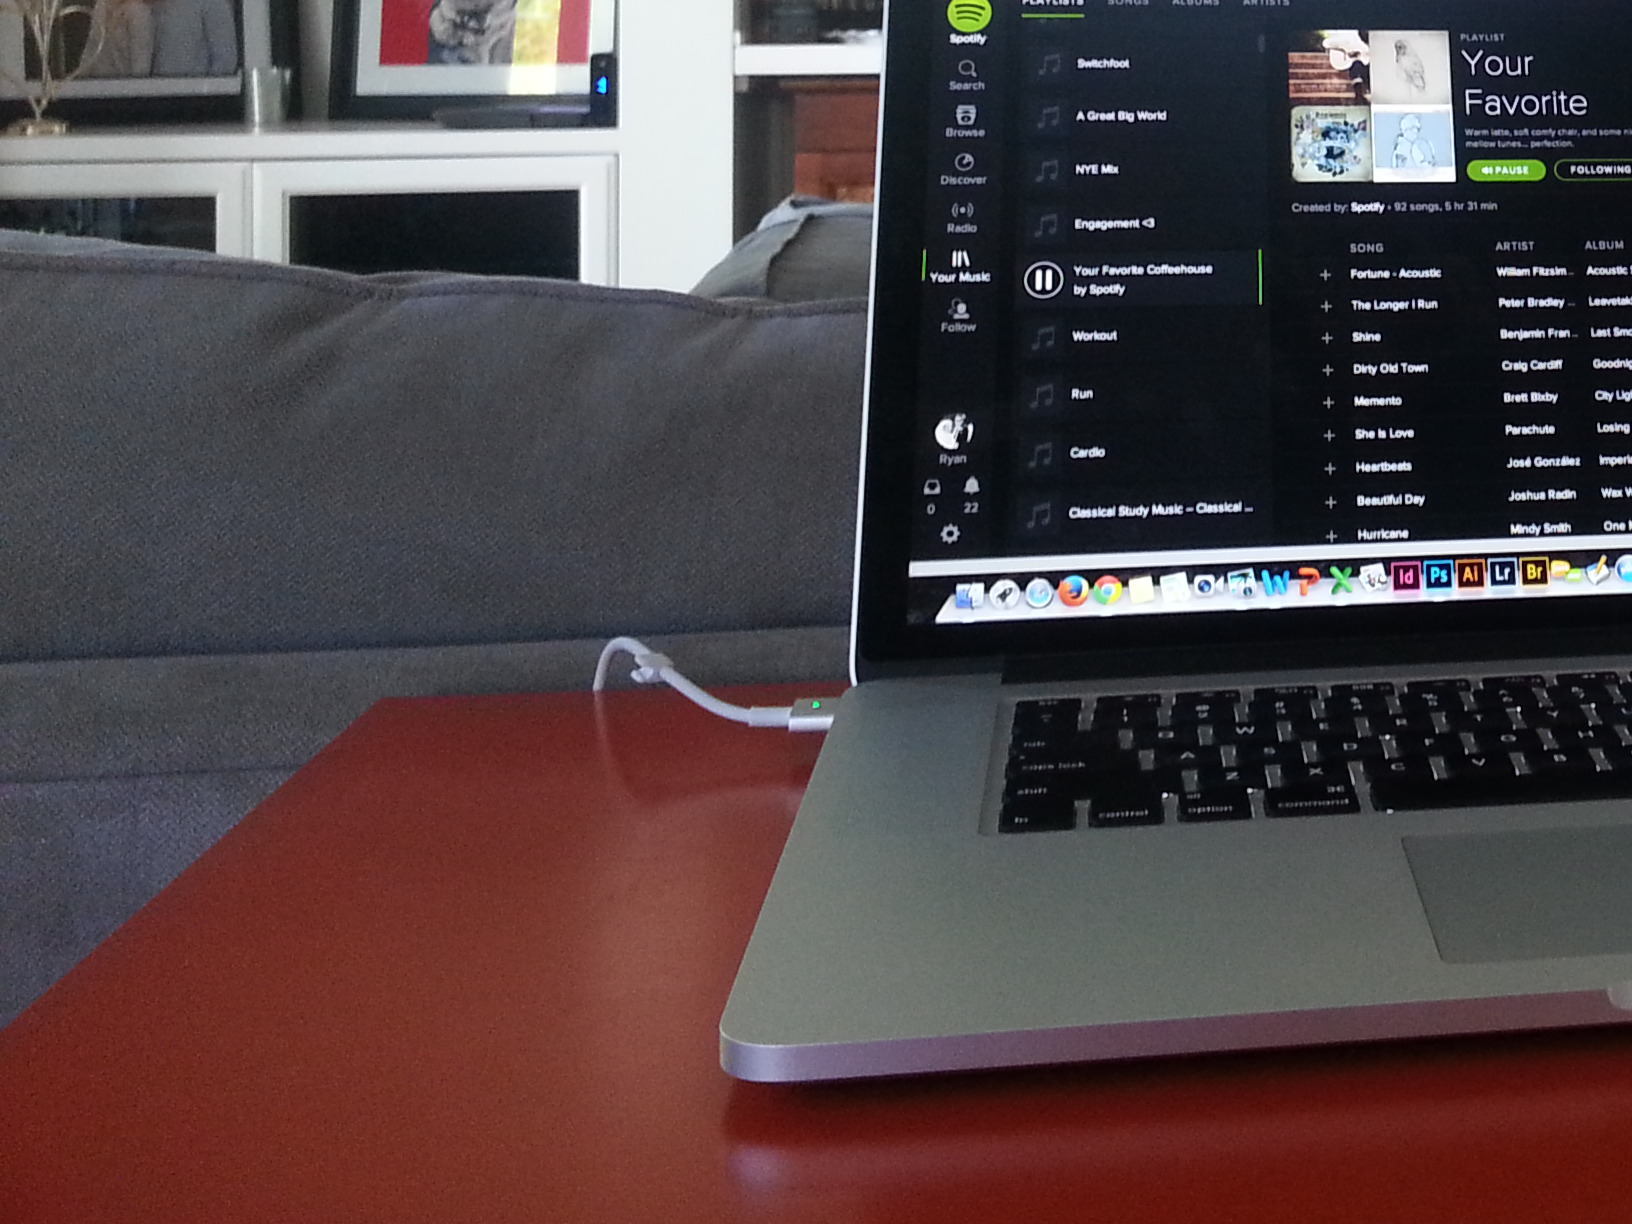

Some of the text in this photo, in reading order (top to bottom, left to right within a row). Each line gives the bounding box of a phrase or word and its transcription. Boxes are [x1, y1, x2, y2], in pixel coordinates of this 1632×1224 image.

[950, 33, 987, 45] Spotify
[1460, 33, 1504, 42] PLAYLIST
[1077, 58, 1130, 68] Switchfoot
[1461, 49, 1534, 76] Your
[949, 81, 985, 91] Search
[1465, 89, 1587, 116] Favorite
[1076, 110, 1167, 123] A Great Big World
[945, 127, 985, 137] Browse
[1075, 164, 1119, 175] NYE Mix
[1495, 166, 1529, 175] PAUSE
[1570, 165, 1632, 175] FOLLOWING
[940, 175, 987, 185] Discover
[1291, 203, 1331, 213] Created
[1351, 201, 1385, 214] Spotify
[1454, 201, 1464, 210] hr
[1467, 201, 1478, 211] 31
[1480, 201, 1498, 210] min
[947, 223, 977, 233] Radio
[1075, 218, 1140, 231] Engagement
[1350, 243, 1384, 253] SONG
[1495, 241, 1534, 251] ARTIST
[1585, 240, 1624, 250] ALBUM
[1073, 264, 1213, 276] Your Favorite Coffeehouse
[1350, 268, 1442, 279] Fortune Acoustic
[1586, 265, 1628, 276] Acoustic
[930, 271, 991, 283] Your Music
[1073, 283, 1125, 297] by Spotify
[1351, 299, 1438, 312] The Longer Run
[1498, 297, 1565, 309] Peter Bradley
[941, 322, 977, 332] Follow
[1590, 327, 1611, 338] Last
[1072, 330, 1117, 341] Workout
[1352, 331, 1381, 342] Shine
[1500, 328, 1545, 341] Benjamin
[1353, 362, 1429, 376] Dirty Old Town
[1501, 360, 1528, 373] Craig
[1071, 388, 1093, 399] Run
[1503, 392, 1529, 403] Brett
[1595, 390, 1614, 403] City
[1354, 395, 1402, 407] Memento
[1355, 427, 1414, 440] She Love
[1505, 424, 1555, 435] Parachute
[1597, 422, 1630, 434] Losing
[1070, 447, 1106, 459] Cardio
[939, 453, 967, 466] Ryan
[1507, 456, 1581, 468] José González
[1356, 461, 1412, 473] Heartbeats
[1508, 489, 1577, 501] Joshua Radin
[1601, 487, 1623, 498] Wax
[1357, 493, 1425, 507] Beautiful Day
[964, 502, 979, 513] 22
[1069, 503, 1183, 519] Classical Study Music
[1510, 522, 1572, 536] Mindy Smith
[1603, 520, 1626, 532] One
[1358, 528, 1409, 540] Hurricane
[1399, 570, 1414, 585] Id
[1430, 569, 1448, 583] Ps
[1462, 567, 1479, 582] Ai
[1495, 567, 1509, 581] Lr
[1526, 566, 1542, 580] Br
